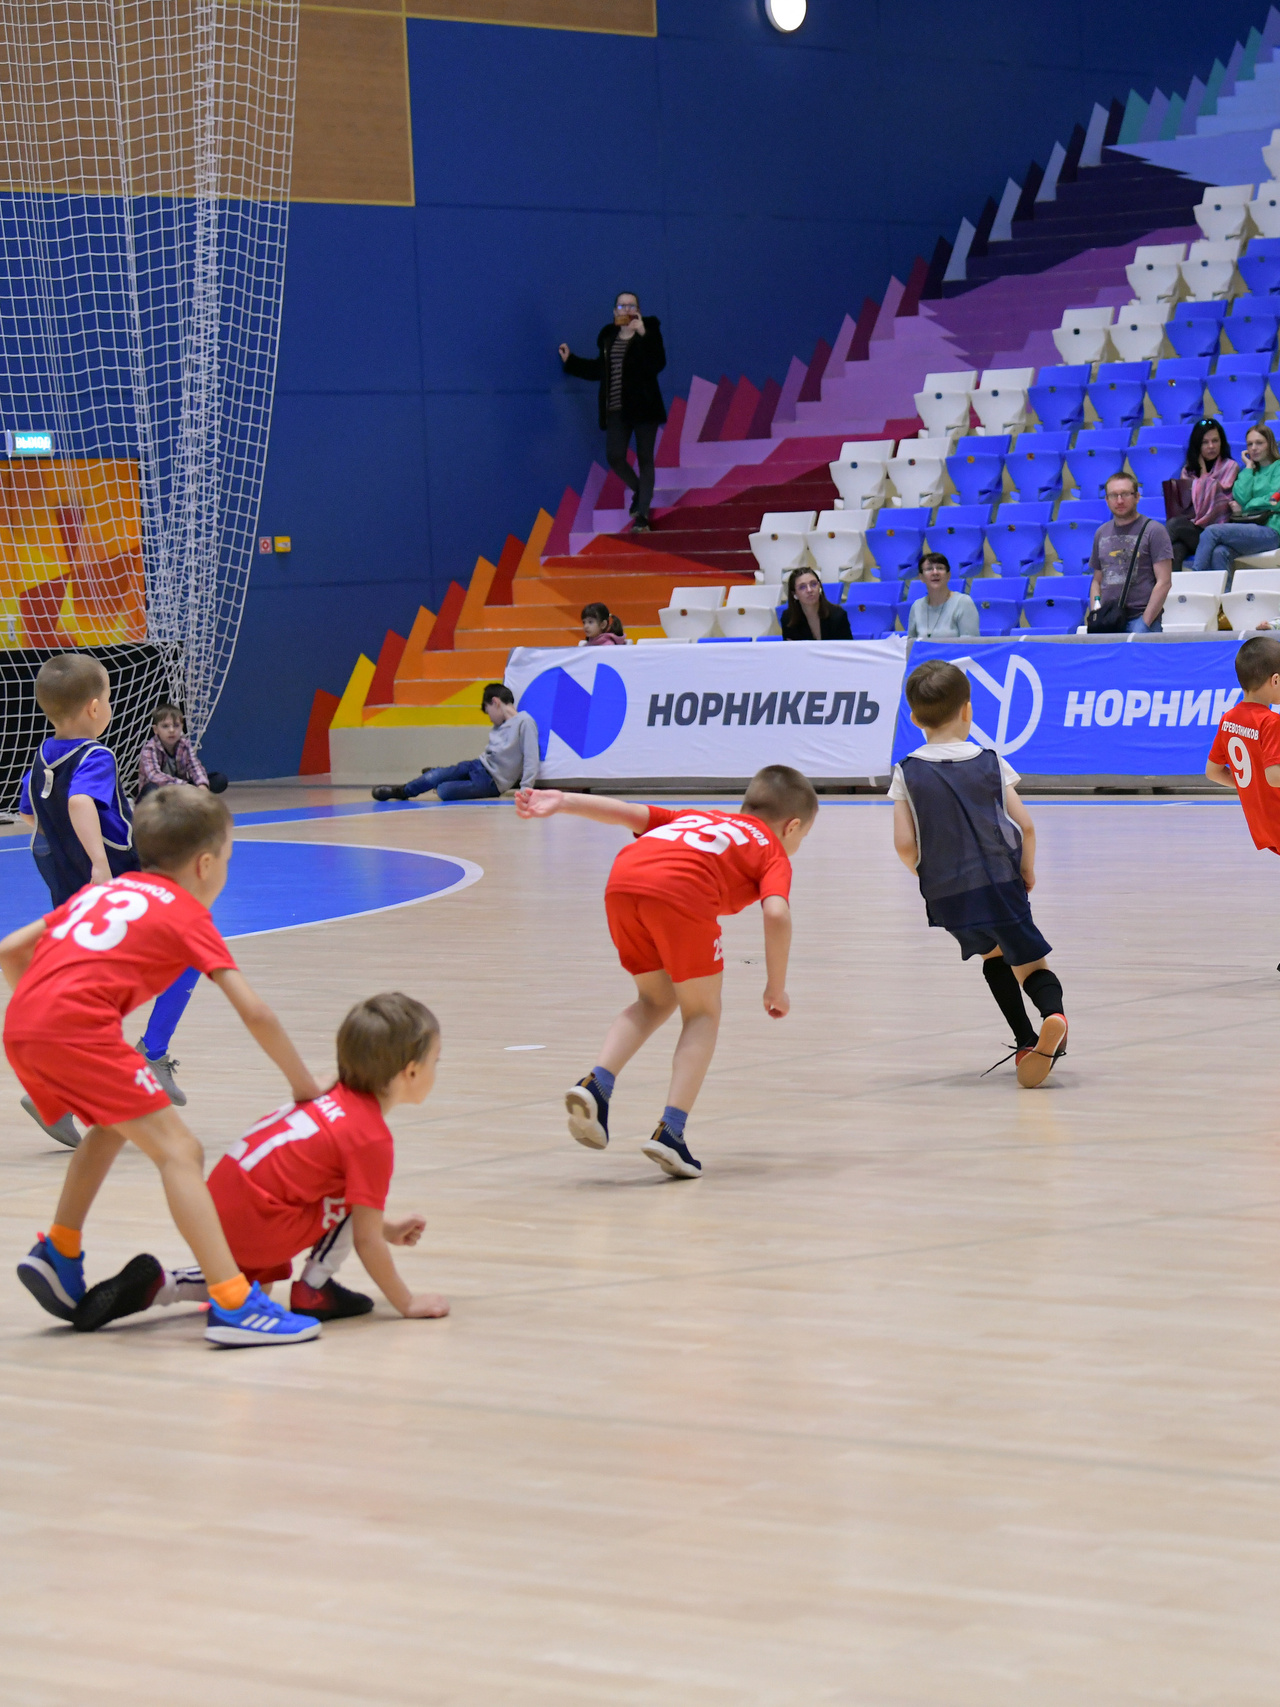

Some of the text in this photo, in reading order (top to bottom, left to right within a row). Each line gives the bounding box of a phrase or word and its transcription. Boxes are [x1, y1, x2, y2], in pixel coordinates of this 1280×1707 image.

[15, 436, 52, 450] ВЫХОД
[647, 691, 880, 726] НОРНИКЕЛЬ
[1227, 736, 1253, 789] 9
[640, 814, 750, 855] 25
[51, 885, 149, 951] 13
